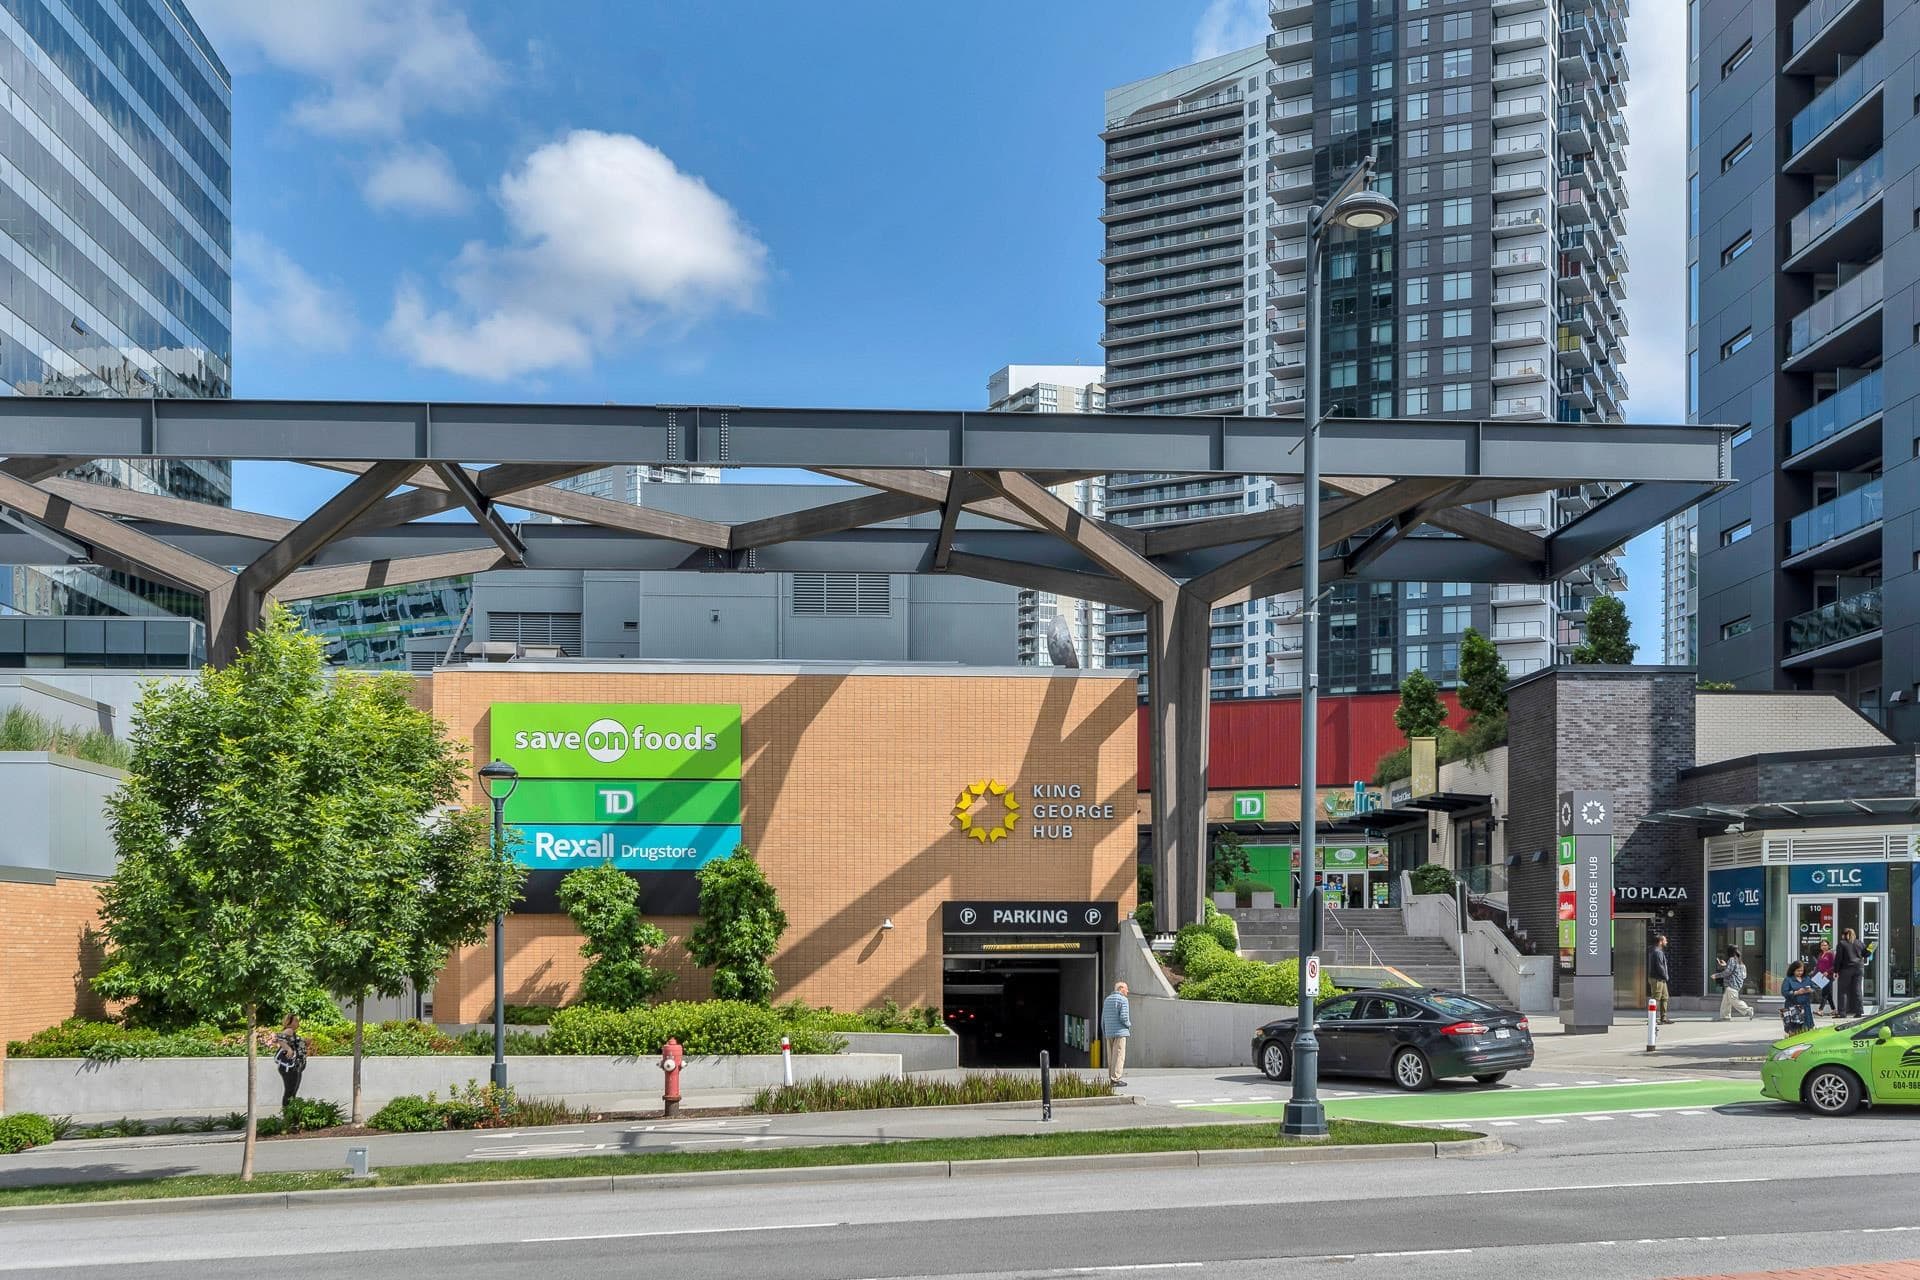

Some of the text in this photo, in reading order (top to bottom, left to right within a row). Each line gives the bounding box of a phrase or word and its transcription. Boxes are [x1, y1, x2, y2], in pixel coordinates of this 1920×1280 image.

[514, 725, 718, 751] save on foods
[1032, 784, 1081, 798] KING
[599, 790, 634, 814] TD
[1236, 797, 1261, 815] TD
[1033, 805, 1114, 819] GEORGE
[1032, 825, 1073, 839] HUB
[535, 832, 697, 861] Rexall Drugstore
[1827, 869, 1862, 884] TLC
[1618, 887, 1688, 899] TO PLAZA
[1717, 891, 1731, 903] TLC
[1744, 889, 1759, 902] TLC
[1589, 856, 1598, 955] KING GEORGE HUB
[993, 909, 1068, 924] PARKING
[1809, 923, 1831, 933] TLC
[1879, 1069, 1920, 1079] SUNSHI
